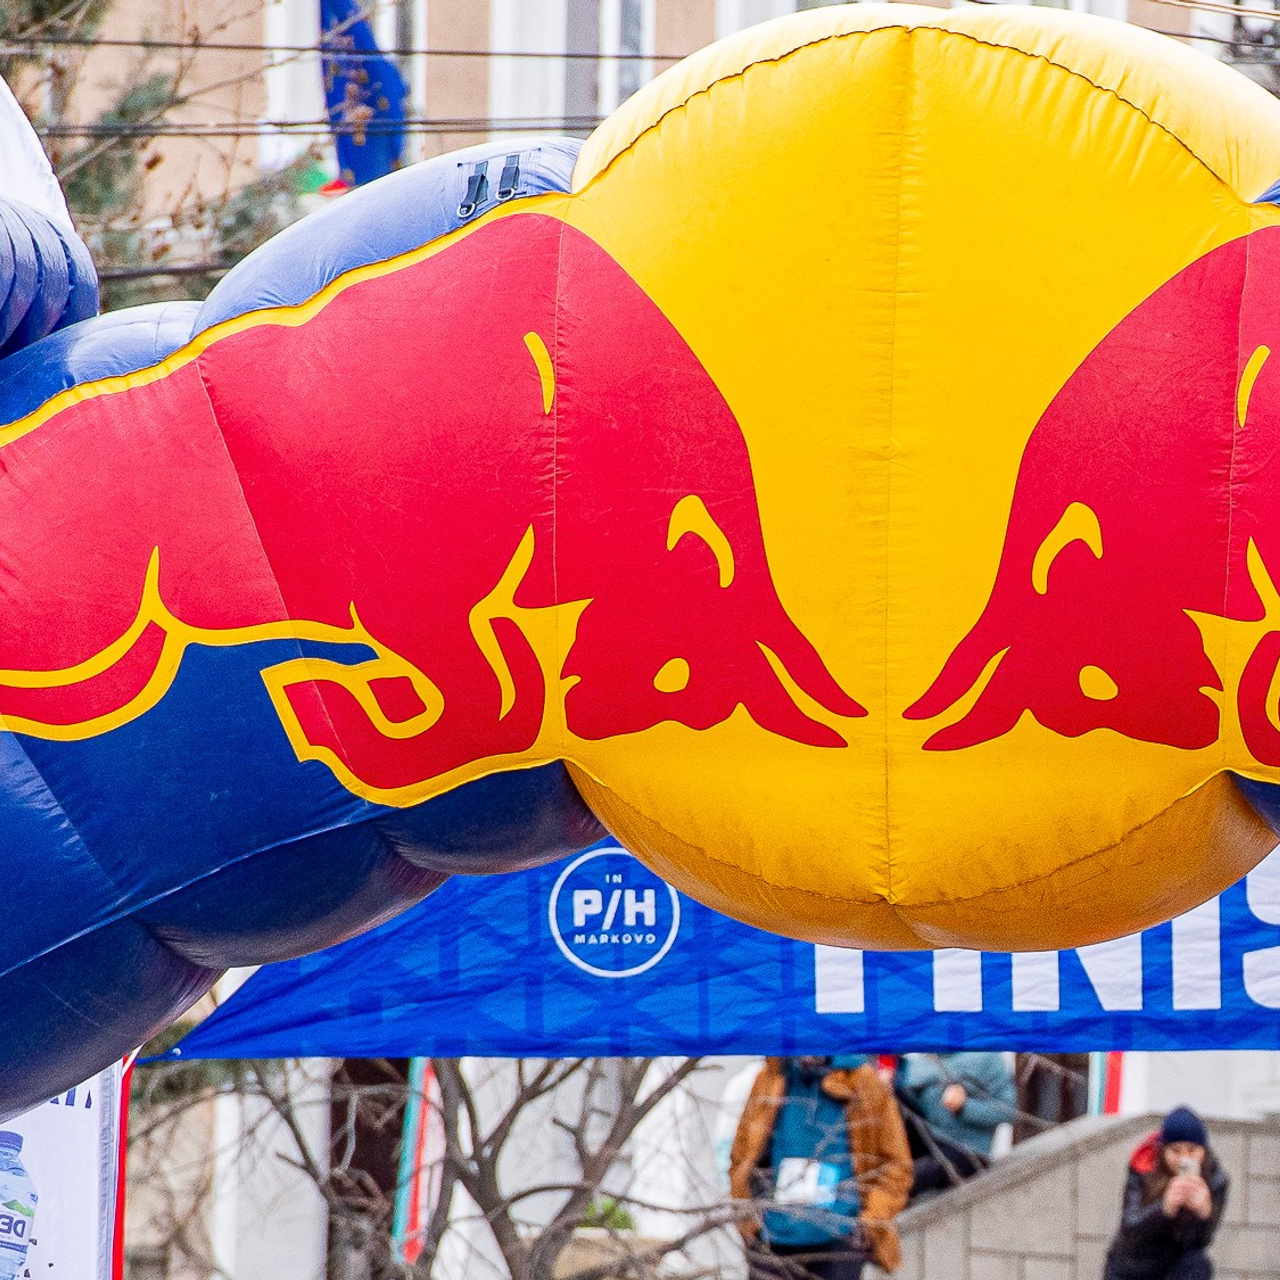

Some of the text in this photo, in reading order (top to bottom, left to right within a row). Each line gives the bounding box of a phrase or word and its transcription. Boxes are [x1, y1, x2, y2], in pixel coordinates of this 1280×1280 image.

[605, 874, 622, 883] IN
[573, 889, 656, 931] P/H
[574, 933, 656, 945] MARKOVO
